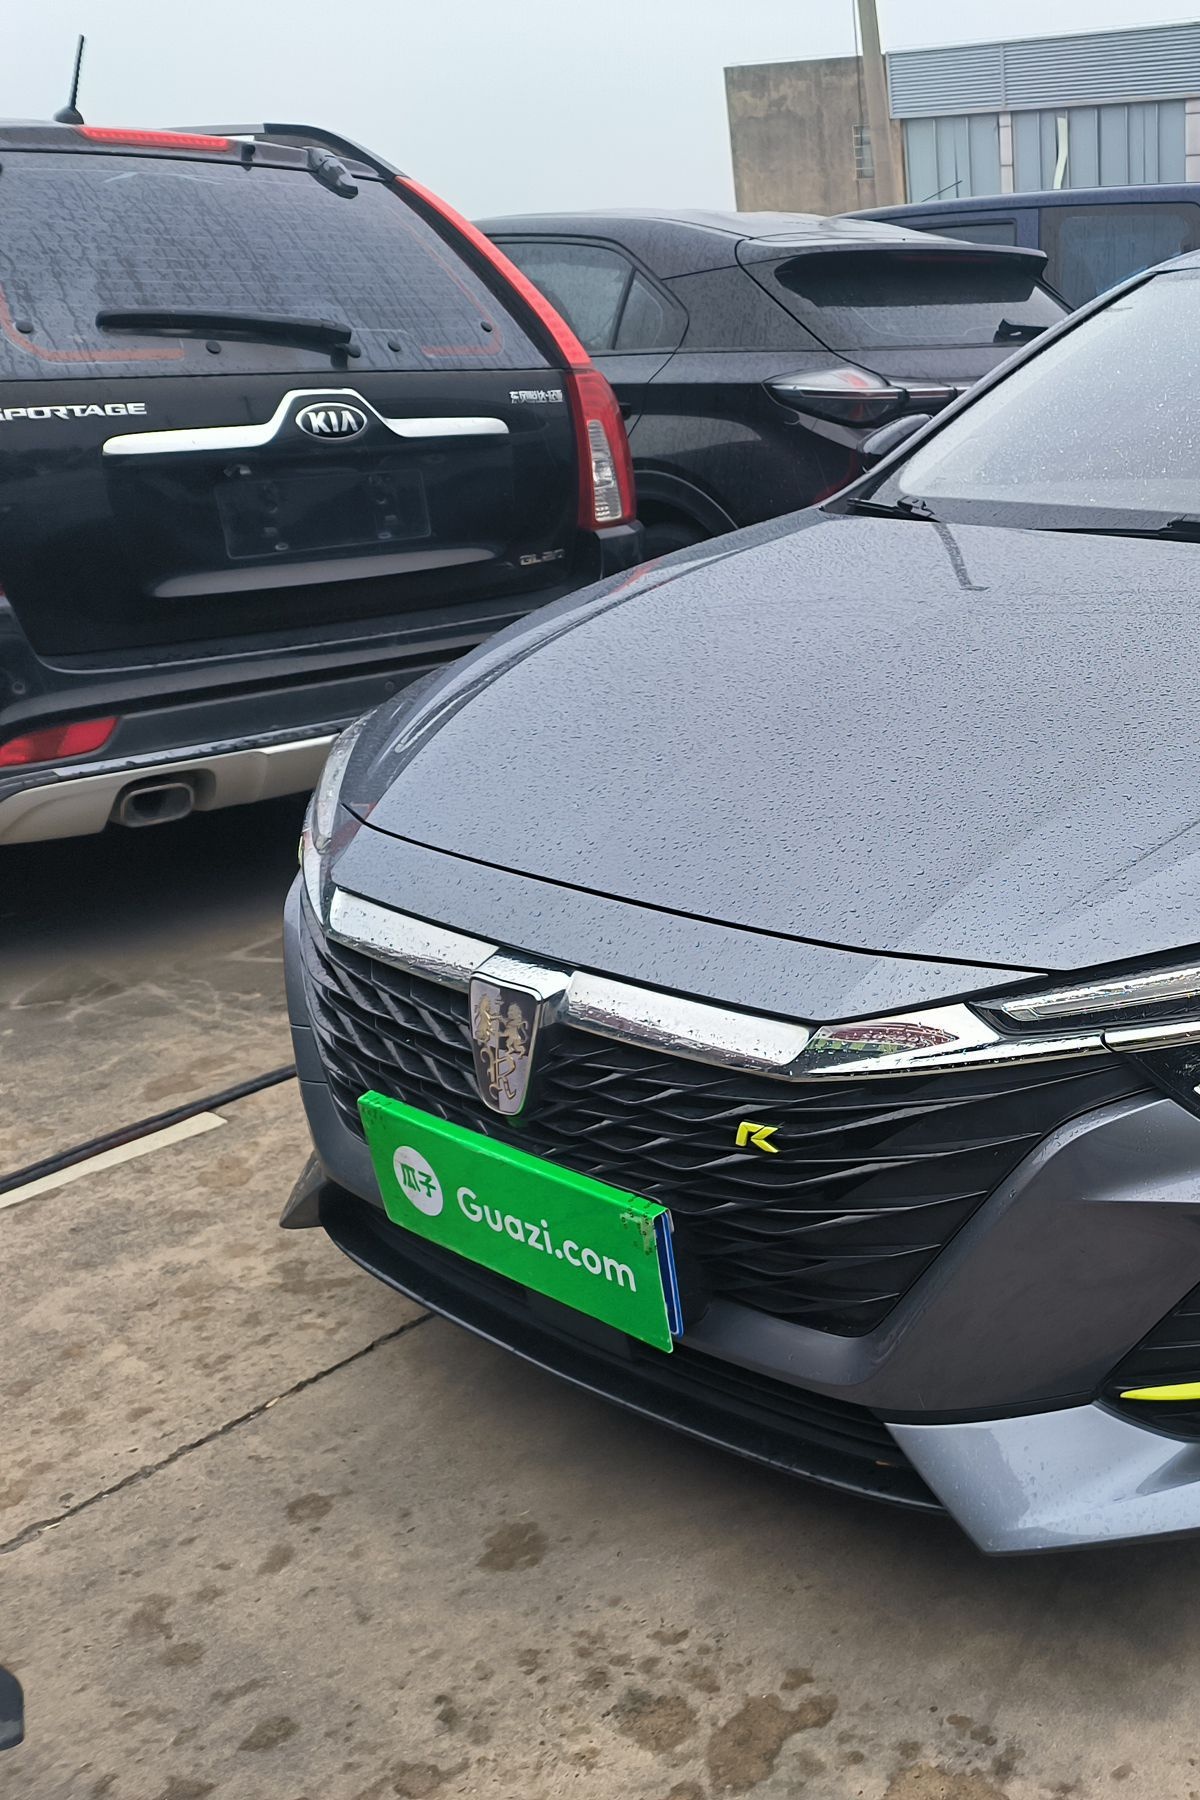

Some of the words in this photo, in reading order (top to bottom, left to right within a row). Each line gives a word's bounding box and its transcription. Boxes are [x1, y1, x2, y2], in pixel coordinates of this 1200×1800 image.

[0, 402, 147, 421] PORTAGE
[306, 410, 359, 433] KIA
[735, 1121, 779, 1153] R
[400, 1163, 436, 1198] 瓜子
[456, 1186, 637, 1293] Guazi.com
